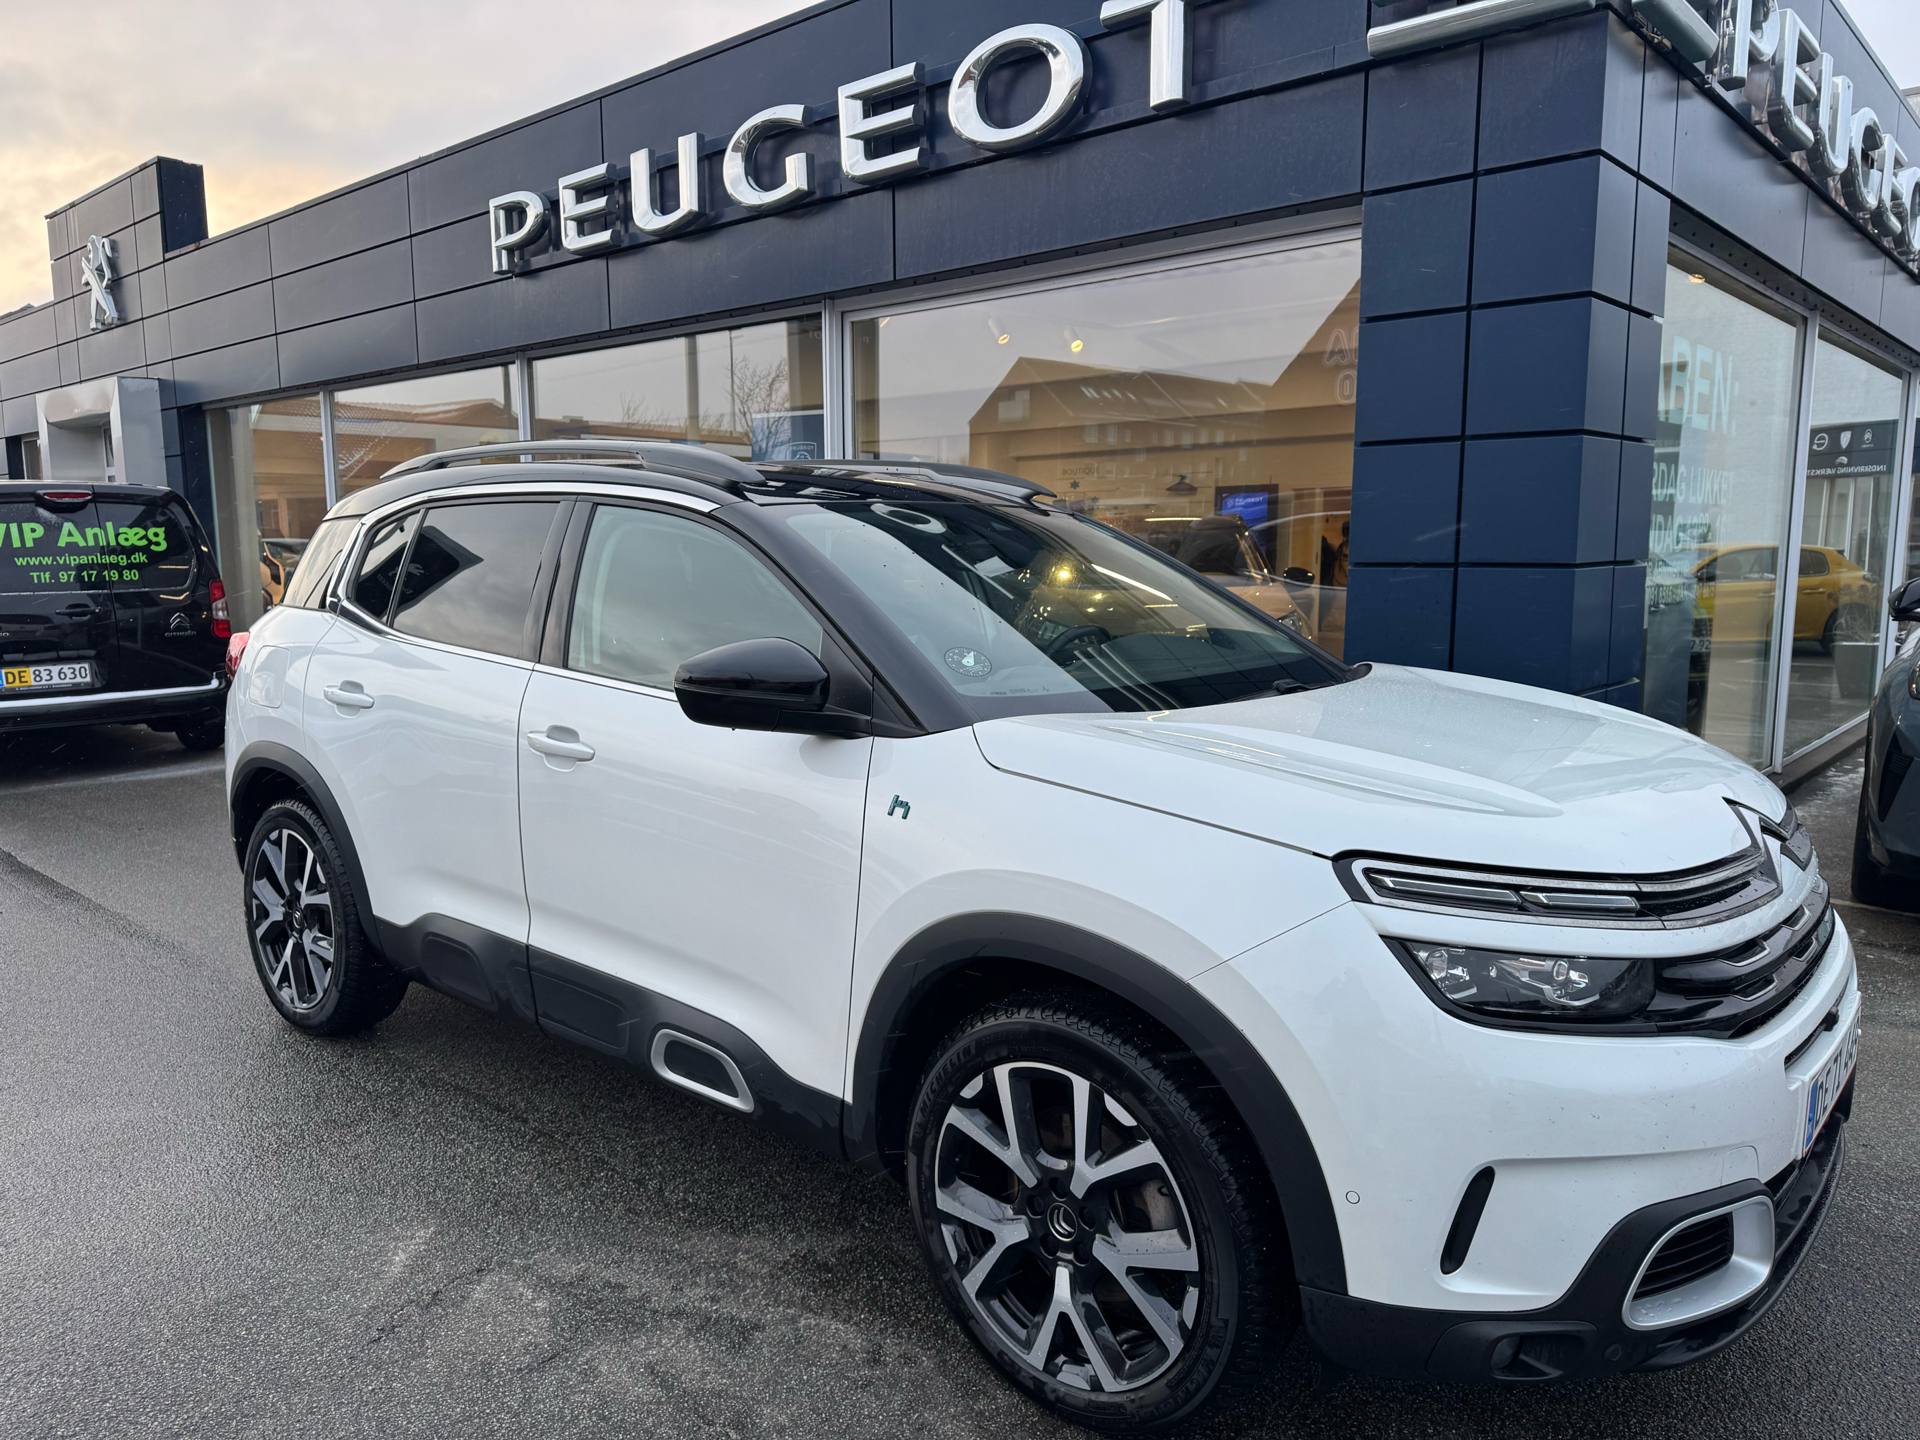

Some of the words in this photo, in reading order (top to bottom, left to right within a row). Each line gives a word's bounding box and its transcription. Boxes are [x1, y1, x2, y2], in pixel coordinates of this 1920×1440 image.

[488, 0, 1195, 274] PEUGEOT
[57, 521, 168, 551] Anlæg
[14, 552, 148, 567] www.vipanlaeg.dk
[29, 571, 55, 584] Tlf.
[58, 570, 76, 583] 97
[81, 570, 98, 582] 17
[102, 569, 119, 582] 19
[122, 569, 140, 581] 80
[4, 670, 29, 685] DE
[32, 668, 54, 683] 83
[57, 665, 89, 681] 630
[919, 1043, 973, 1119] MICHELIN
[1815, 1065, 1831, 1130] DE
[1831, 1046, 1843, 1102] 71
